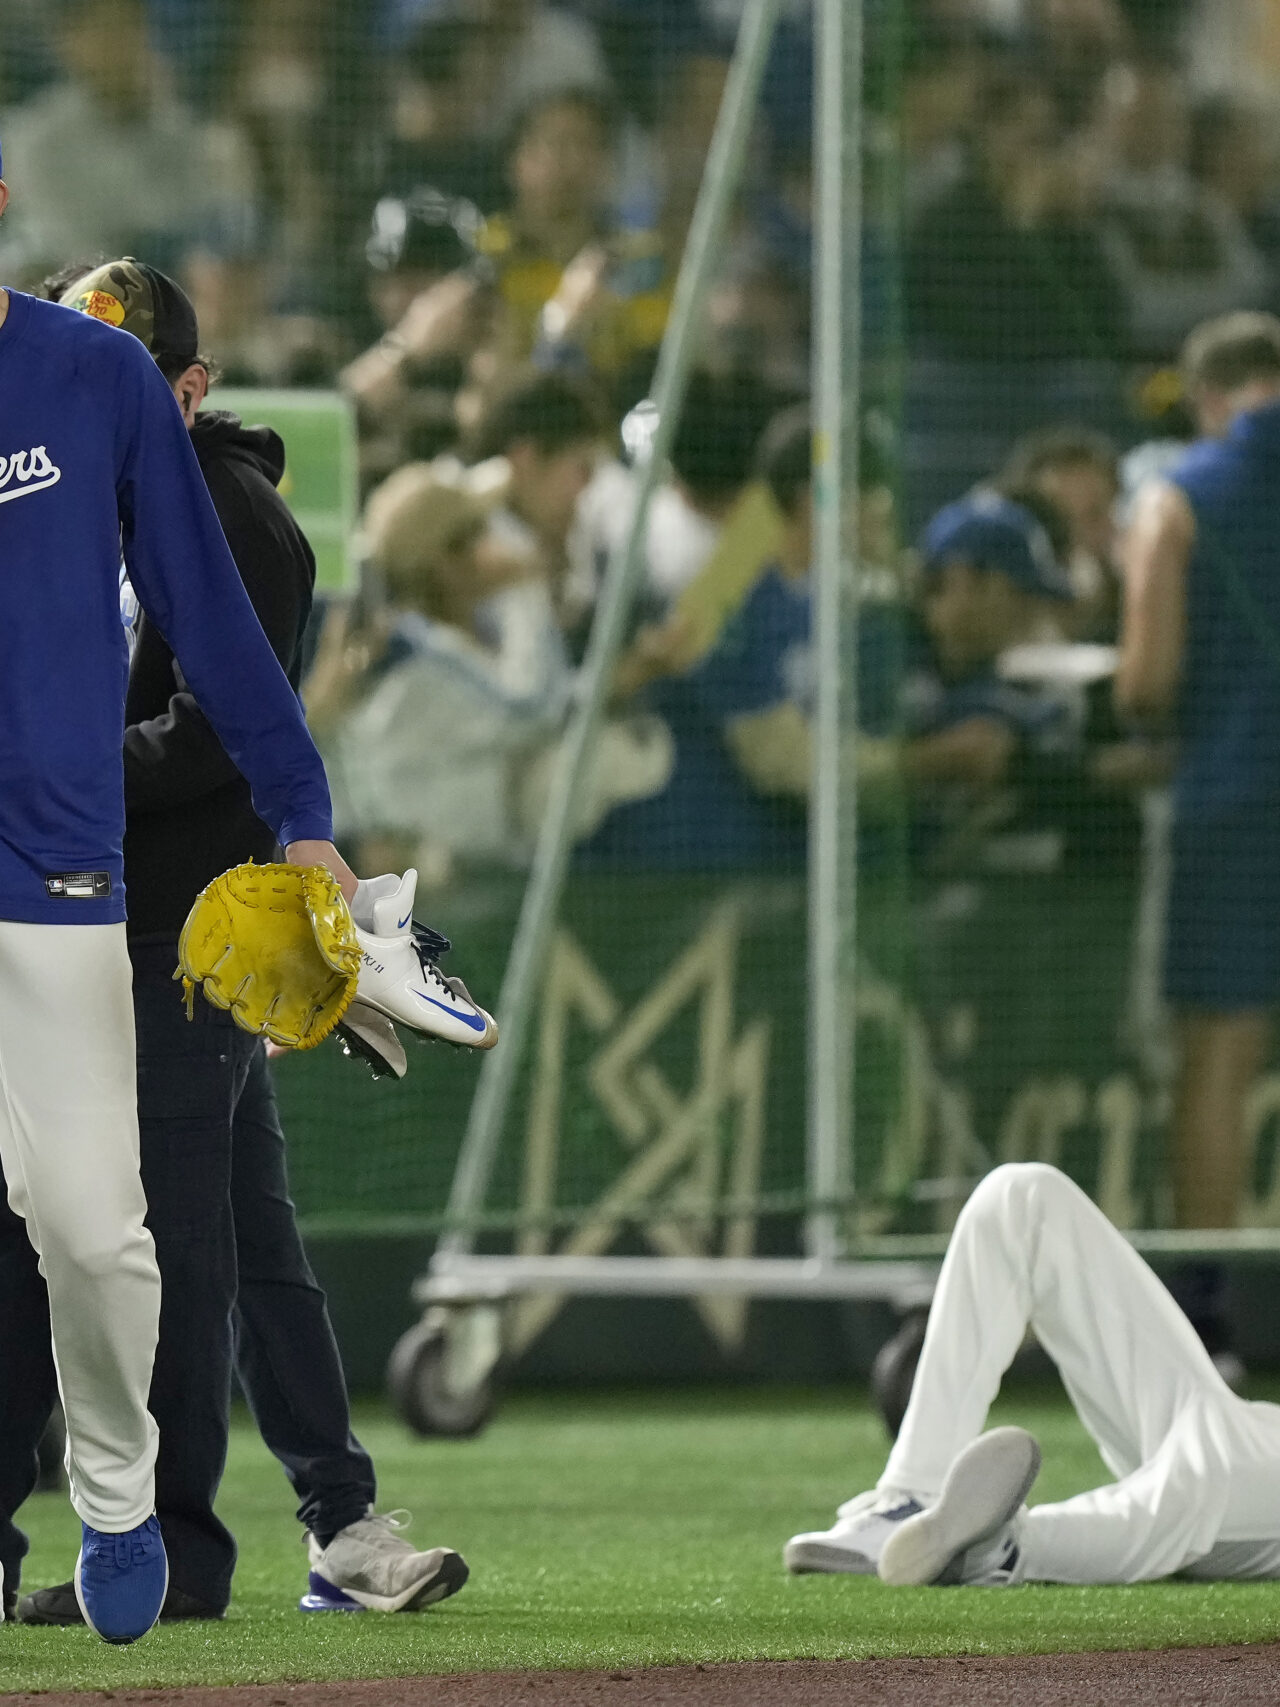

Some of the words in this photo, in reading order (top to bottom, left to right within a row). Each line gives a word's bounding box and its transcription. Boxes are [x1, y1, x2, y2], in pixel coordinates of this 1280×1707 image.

[90, 290, 117, 307] Bass
[87, 303, 107, 315] Pro
[362, 952, 376, 966] KI
